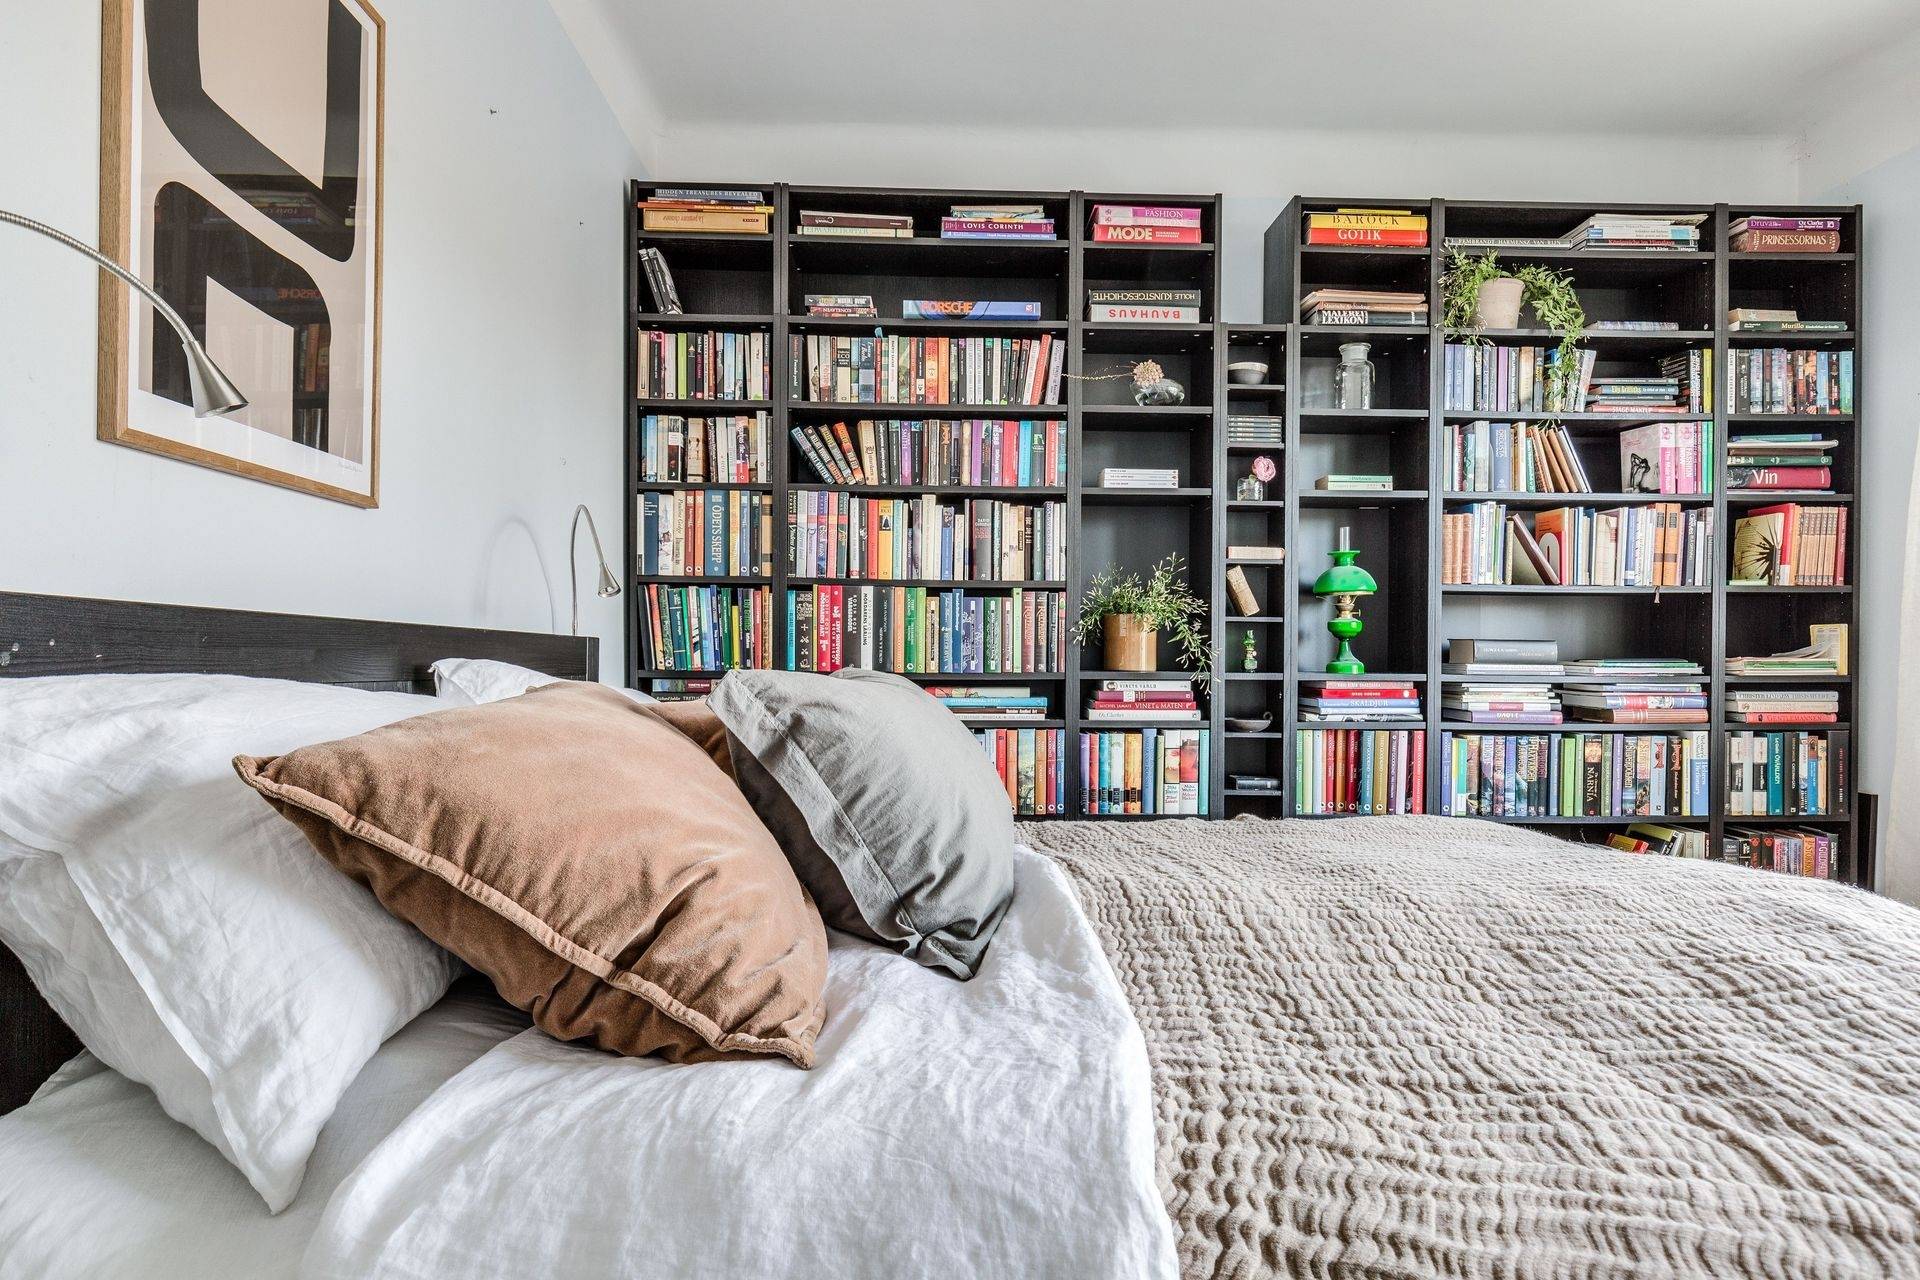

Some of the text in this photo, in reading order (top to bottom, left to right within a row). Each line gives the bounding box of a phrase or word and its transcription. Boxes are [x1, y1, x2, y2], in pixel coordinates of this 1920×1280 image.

[1332, 215, 1399, 225] BAROCK
[1108, 227, 1152, 240] MODE
[1338, 230, 1381, 240] GOTIK
[1762, 235, 1826, 245] PRINSESSORNAS
[920, 302, 973, 313] PORSCHE
[1109, 309, 1180, 318] BAUHAUS
[1322, 315, 1364, 324] LEXIKON
[1752, 469, 1778, 484] Vin
[711, 505, 724, 563] ÖDETS SKEPP
[1693, 762, 1701, 795] Dictionary
